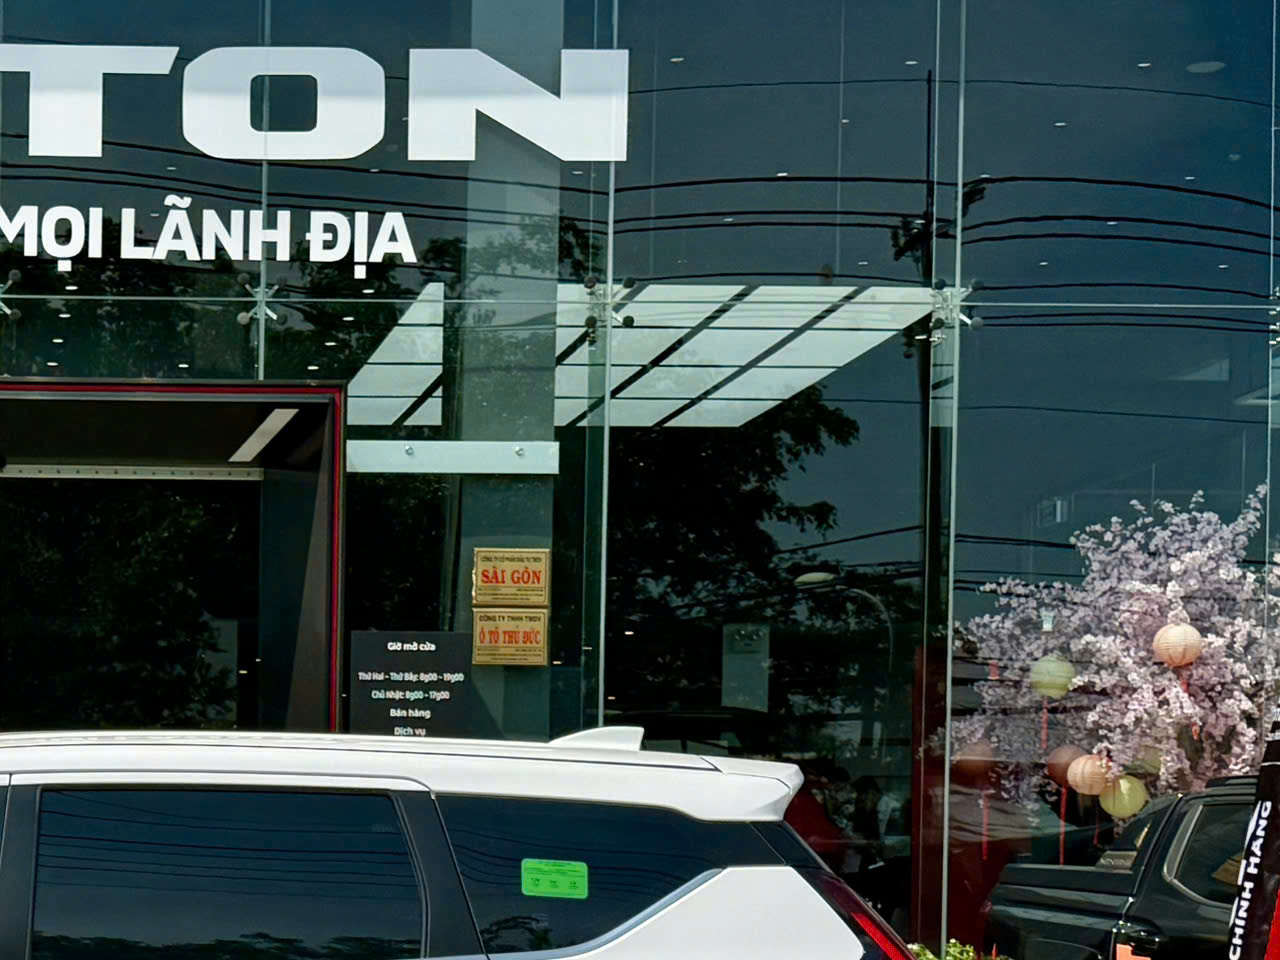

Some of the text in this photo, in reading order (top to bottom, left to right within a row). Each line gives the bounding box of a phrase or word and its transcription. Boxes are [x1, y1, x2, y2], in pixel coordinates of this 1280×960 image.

[121, 193, 291, 263] LÃNH
[305, 209, 418, 280] ĐỊA
[390, 708, 407, 717] Bán
[394, 727, 413, 736] Dịch
